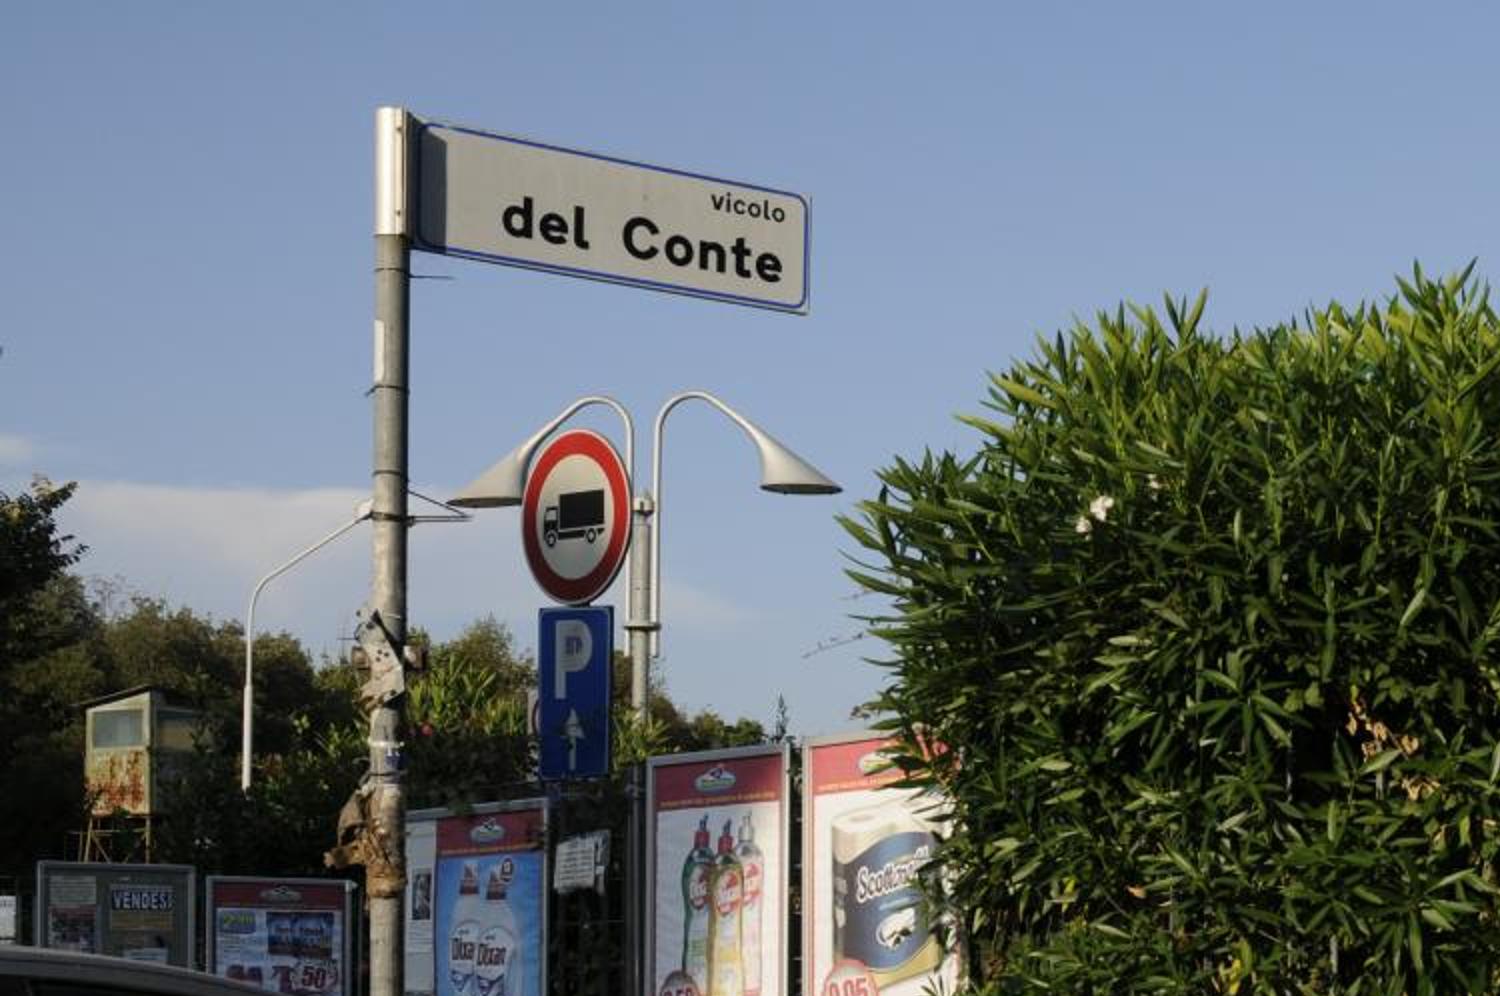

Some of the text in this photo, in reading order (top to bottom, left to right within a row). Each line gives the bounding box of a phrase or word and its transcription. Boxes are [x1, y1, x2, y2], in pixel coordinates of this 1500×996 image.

[711, 192, 786, 223] vicolo
[502, 196, 783, 283] del Conte
[555, 619, 593, 699] P
[452, 937, 475, 961] Dixa
